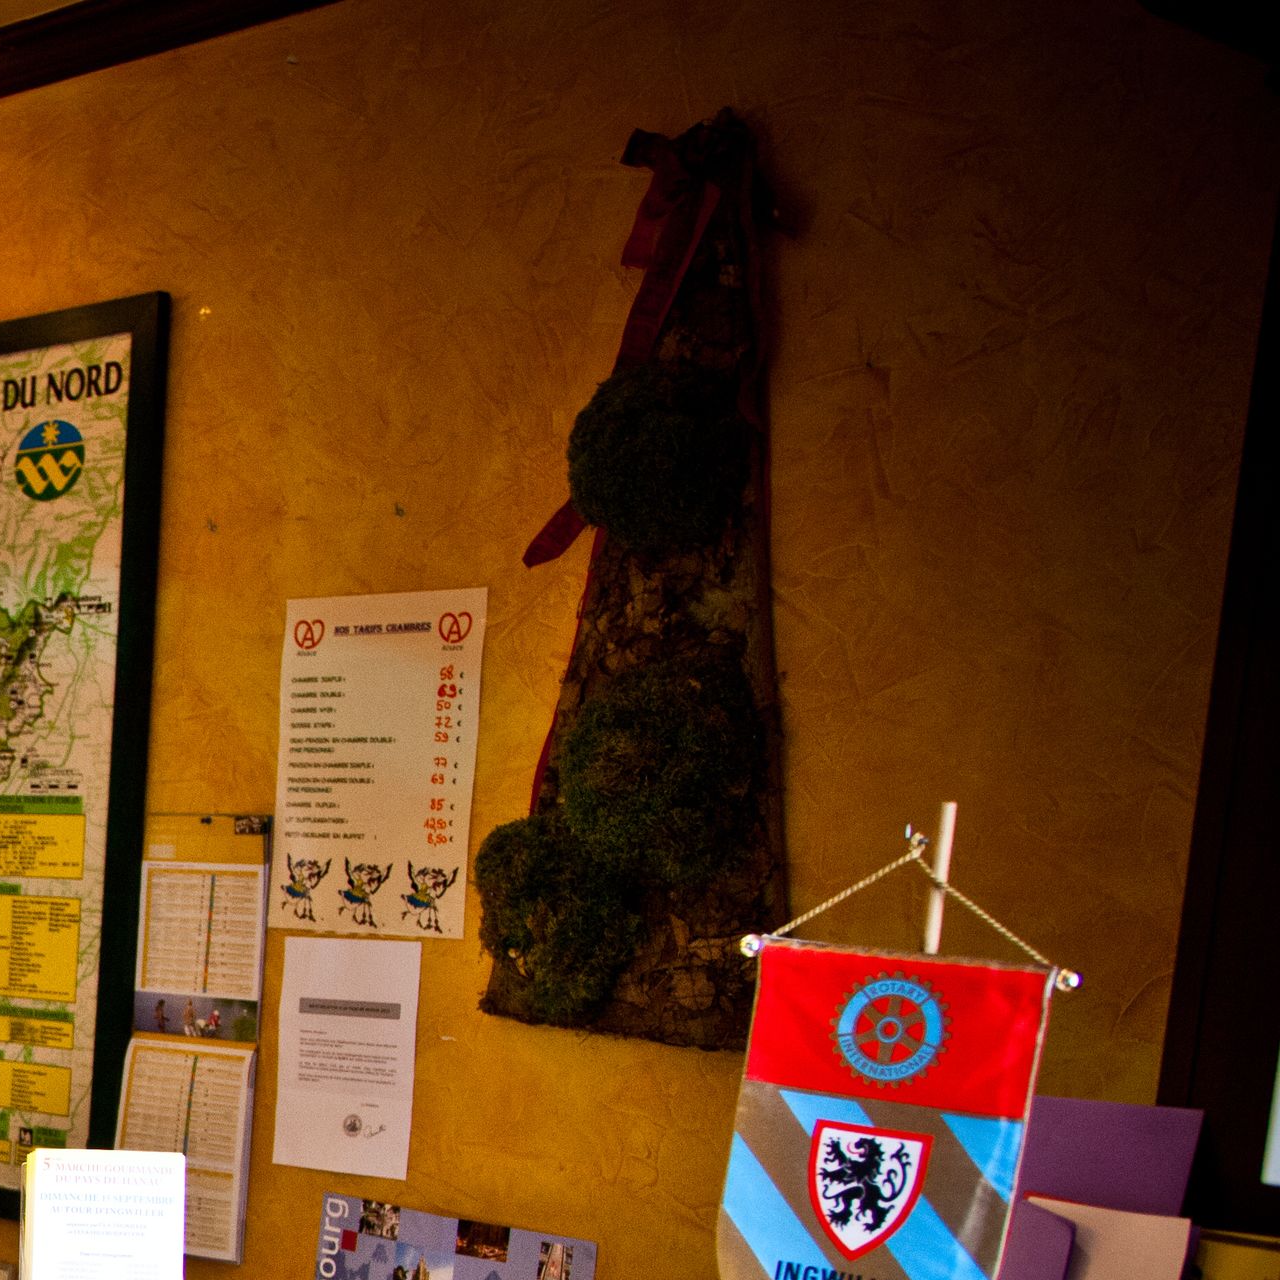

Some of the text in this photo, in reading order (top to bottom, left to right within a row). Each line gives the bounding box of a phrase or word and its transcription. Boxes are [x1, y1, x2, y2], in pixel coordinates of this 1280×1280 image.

[3, 376, 37, 411] DU
[47, 361, 124, 405] NORD
[354, 624, 383, 635] TARIFS
[386, 621, 432, 634] CHAMBRES
[439, 664, 454, 680] 58
[436, 701, 452, 711] 50
[434, 716, 453, 728] 72
[434, 732, 449, 743] 59
[430, 798, 444, 811] 85
[868, 982, 926, 1001] ROTARY
[840, 1039, 935, 1077] INTERNATIONAL
[42, 1157, 52, 1171] 5
[104, 1164, 176, 1176] GOURMANDE
[55, 1175, 71, 1184] DU
[74, 1175, 101, 1184] PAYS
[103, 1176, 120, 1185] DE
[40, 1192, 98, 1202] DIMANCHE
[112, 1194, 175, 1205] SEPTEMBRE
[50, 1206, 165, 1217] AUTOUR D'INGWILLER
